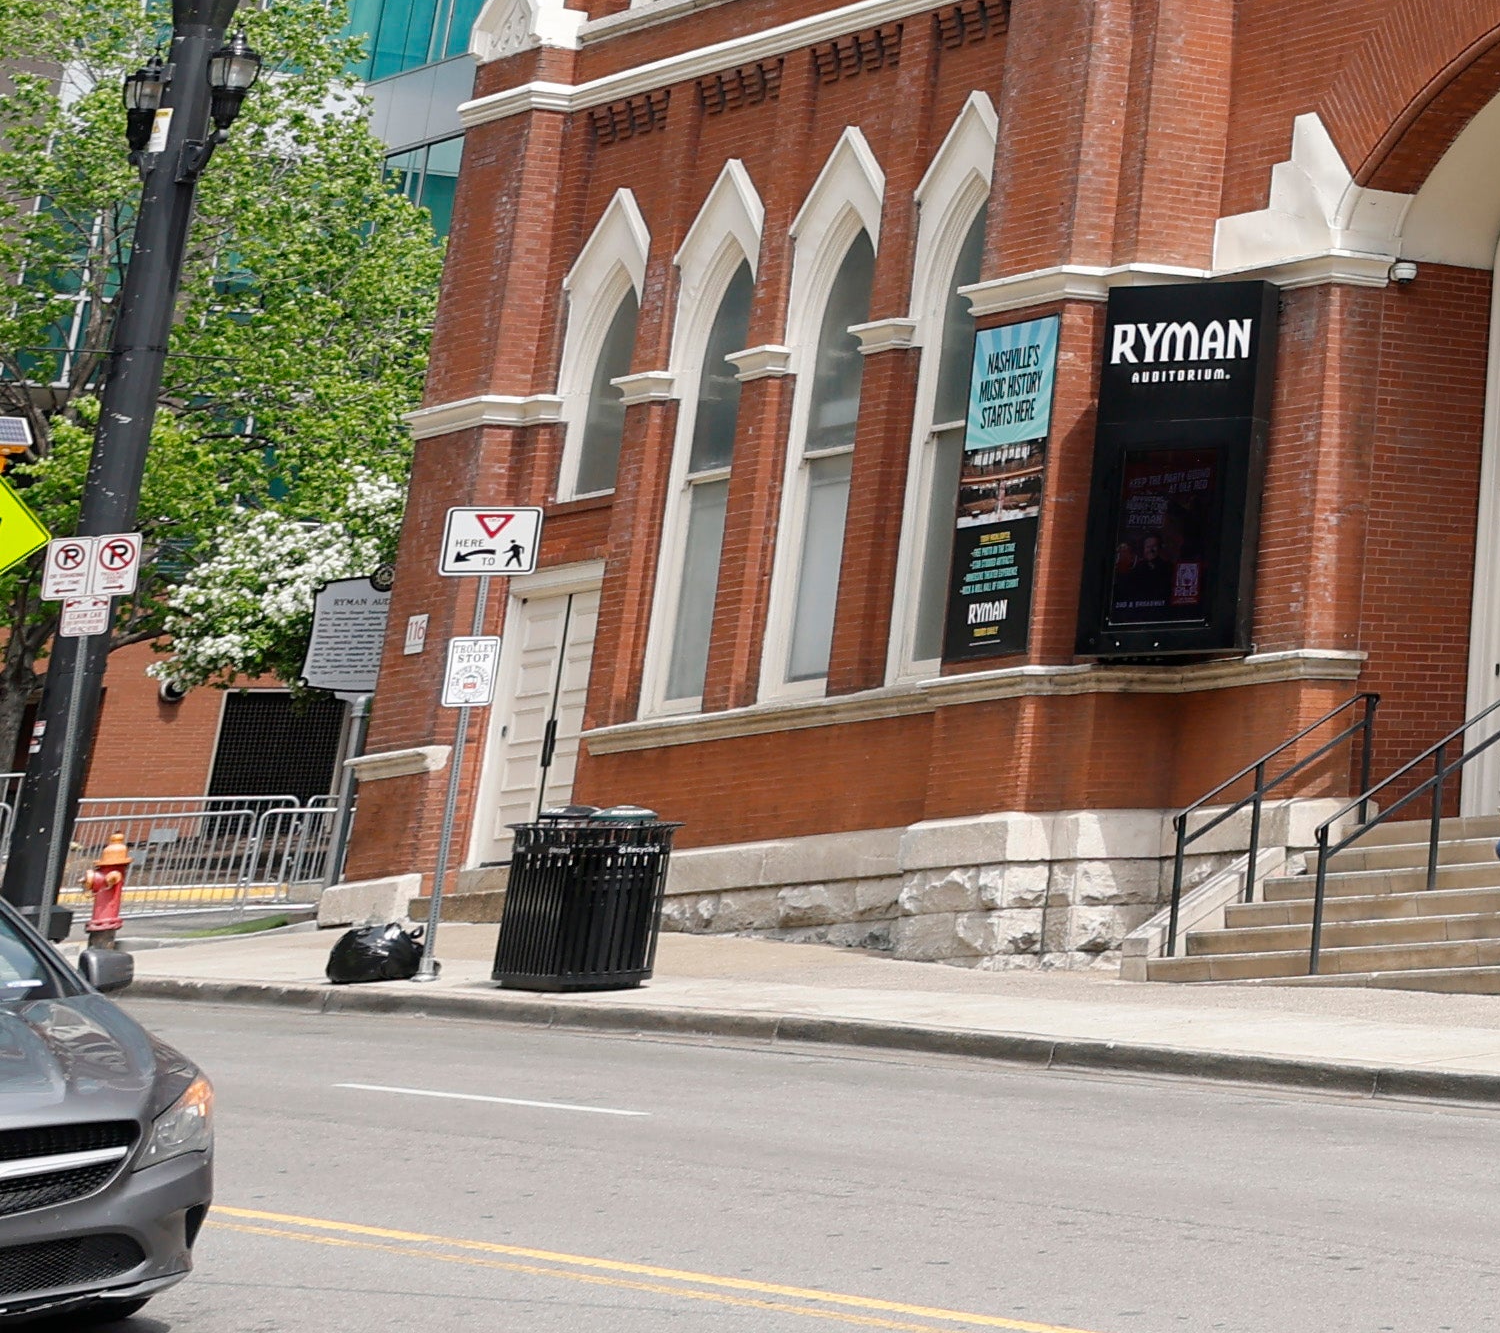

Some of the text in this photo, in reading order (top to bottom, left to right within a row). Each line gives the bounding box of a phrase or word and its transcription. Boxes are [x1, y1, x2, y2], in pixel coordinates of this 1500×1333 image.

[1110, 318, 1253, 364] RYMAN
[987, 344, 1041, 375] NASHVILLE'S
[1132, 368, 1225, 383] AUDITORIUM
[979, 370, 1043, 403] MUSIC HISTORY
[980, 398, 1036, 429] STARTS HERE
[455, 539, 485, 548] HERE
[481, 557, 496, 566] TO
[334, 598, 367, 606] RYMAN
[967, 599, 1008, 625] RYMAN
[409, 619, 426, 641] 116
[453, 644, 497, 654] TROLLEY
[457, 653, 490, 663] STOP
[627, 845, 654, 854] Recycle
